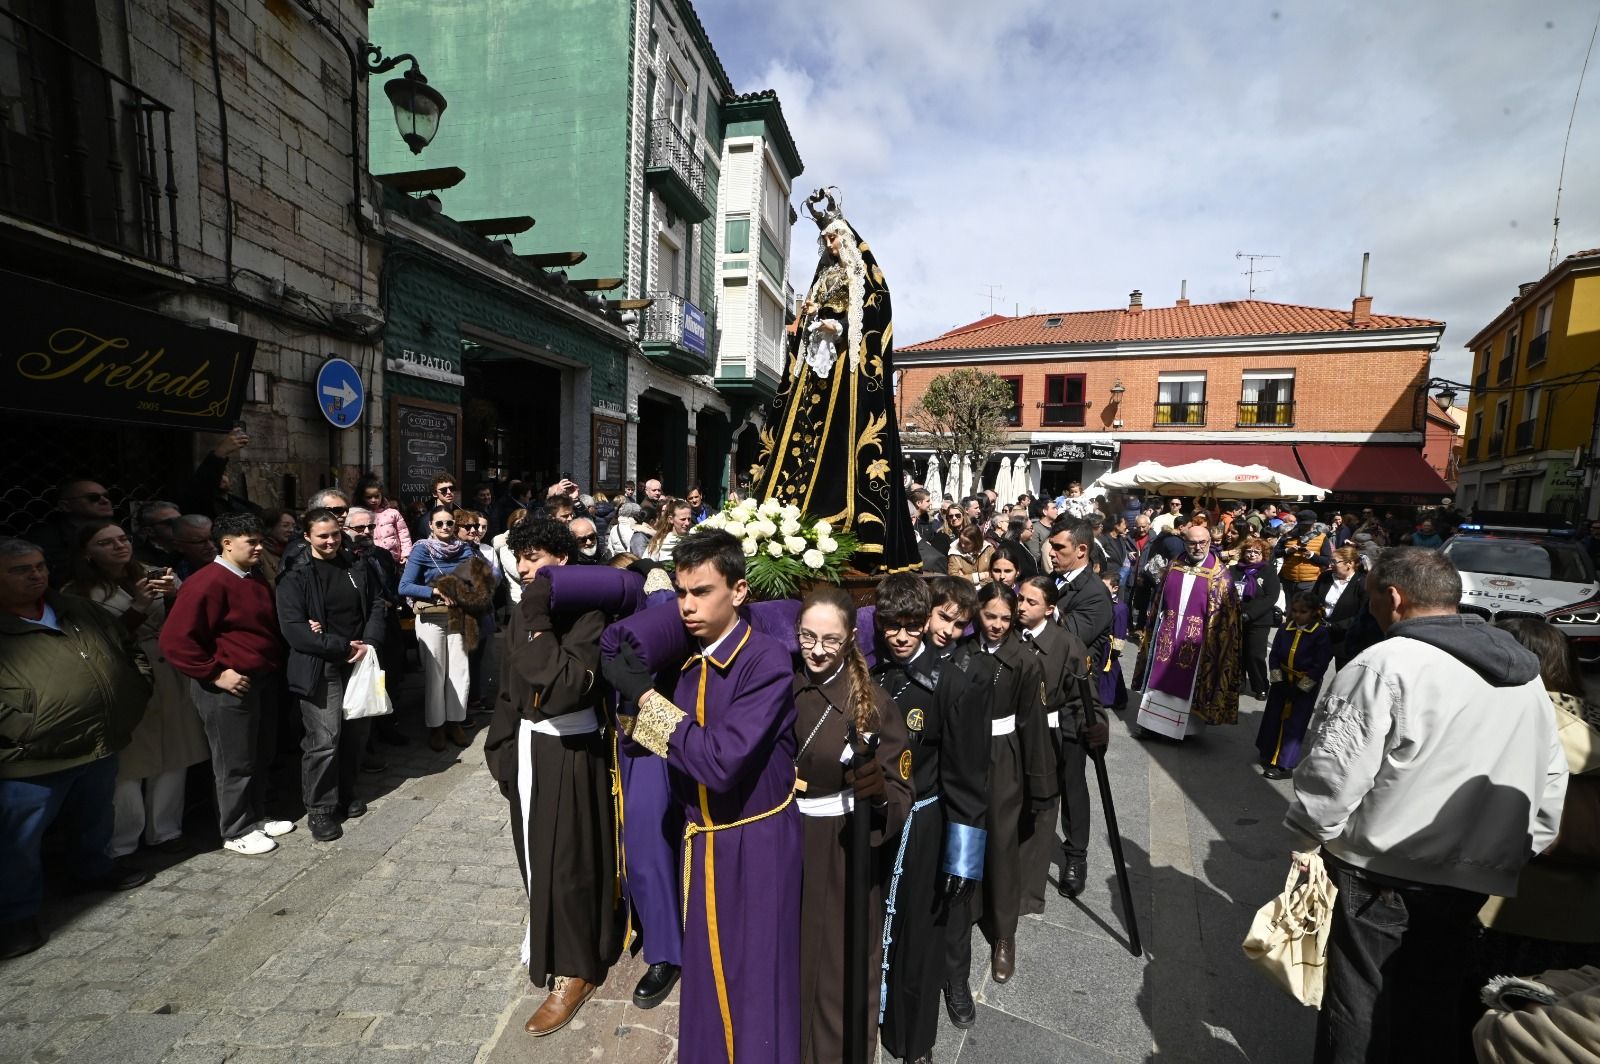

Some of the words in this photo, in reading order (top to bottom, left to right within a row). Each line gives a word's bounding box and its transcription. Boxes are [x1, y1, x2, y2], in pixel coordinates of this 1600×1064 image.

[16, 327, 210, 399] Trébede
[403, 350, 417, 364] EL
[420, 353, 452, 372] PATIO
[136, 400, 160, 412] 2005
[598, 399, 606, 408] EL
[607, 401, 622, 412] PATIO
[402, 483, 426, 493] CARNES
